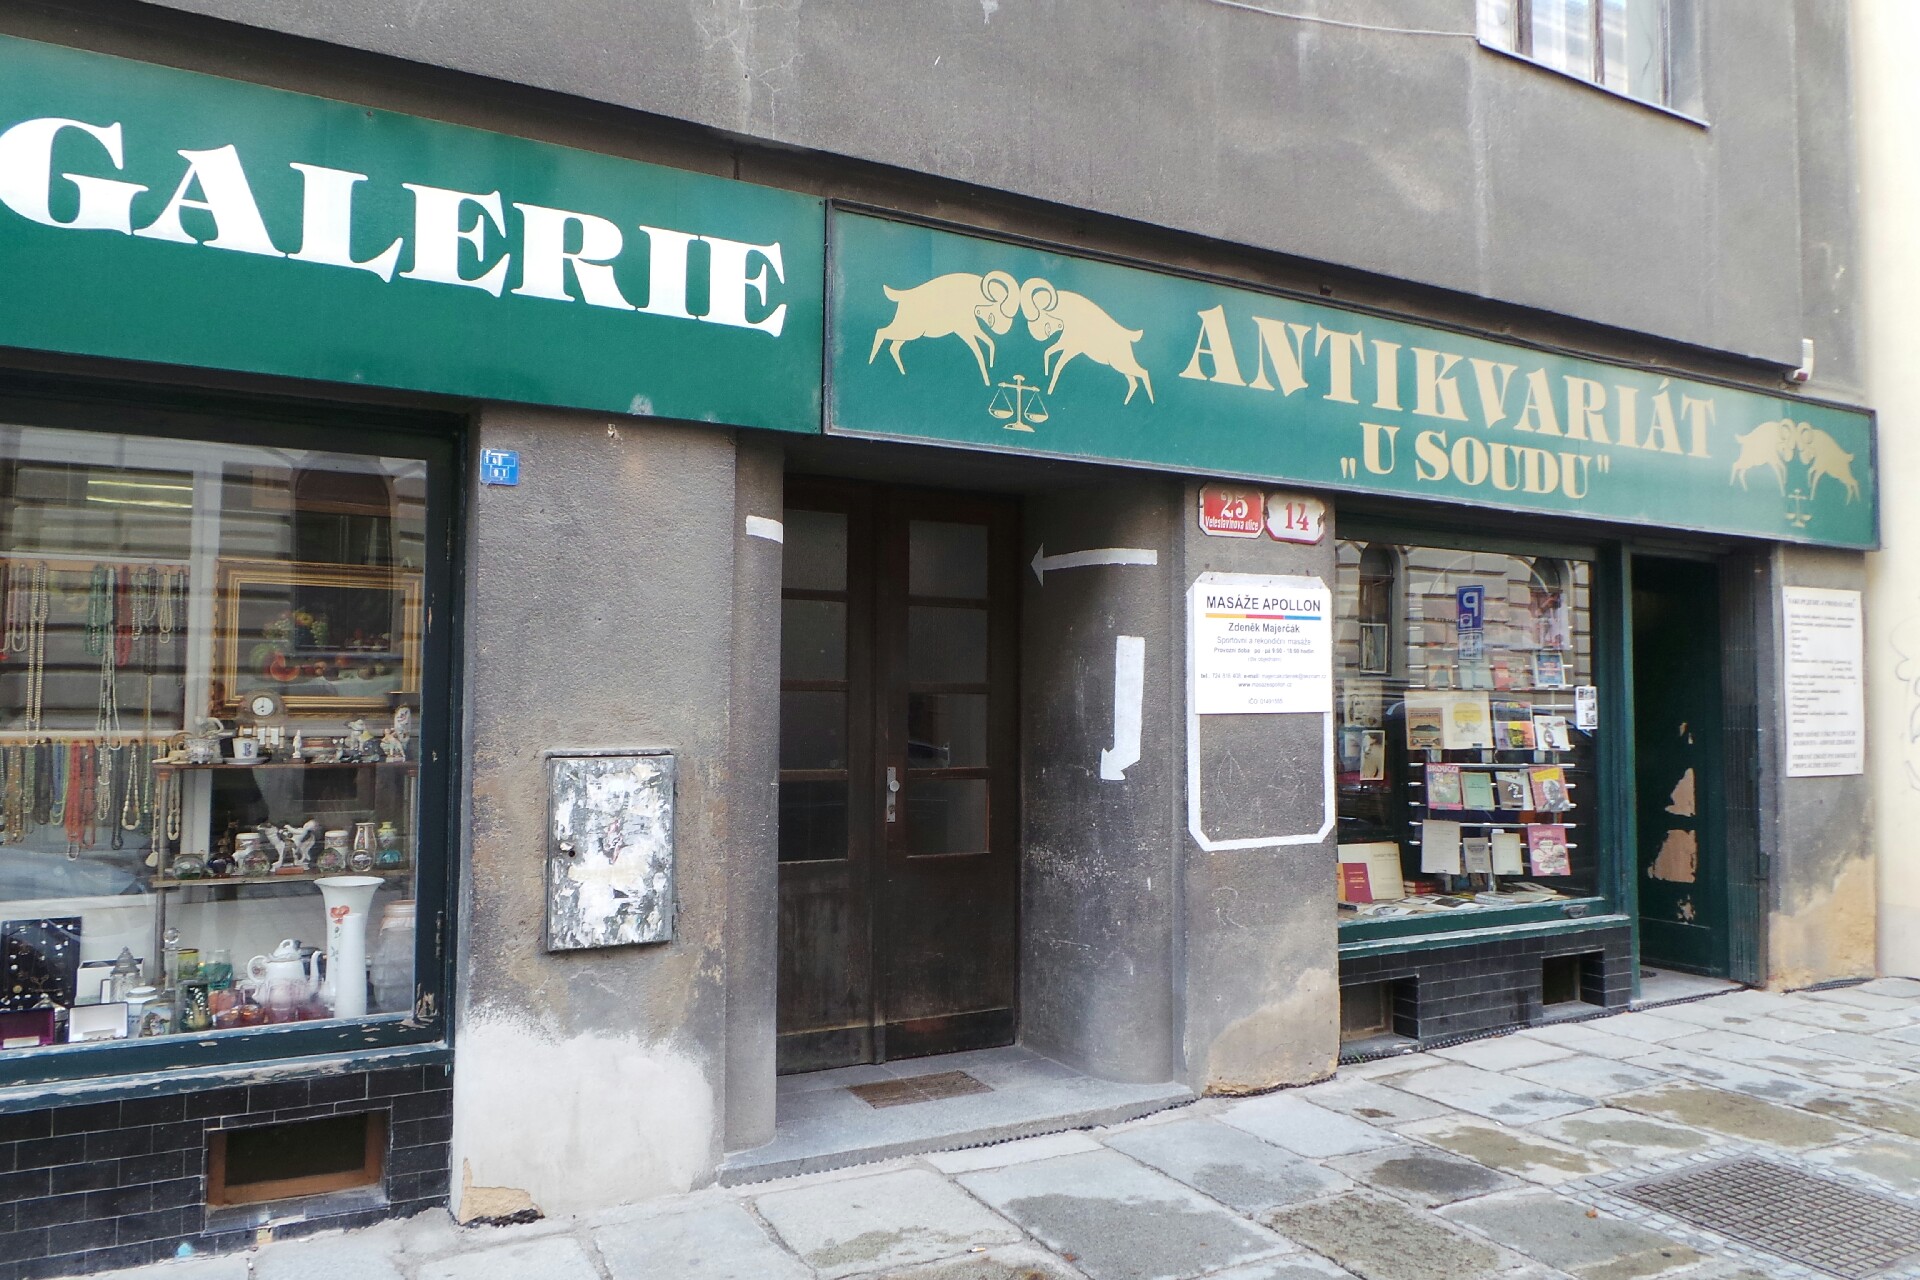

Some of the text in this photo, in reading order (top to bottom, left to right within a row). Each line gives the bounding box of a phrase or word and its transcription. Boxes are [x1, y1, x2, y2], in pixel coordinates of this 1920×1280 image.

[0, 116, 787, 338] GALERIE
[1179, 304, 1715, 459] ANTIKVARIÁT
[1220, 490, 1248, 518] 25
[1285, 501, 1309, 531] 14
[1244, 519, 1259, 531] ulice
[1206, 594, 1321, 612] MASÁŽE APOLLON
[1228, 622, 1301, 635] Zdeněk Majerčák
